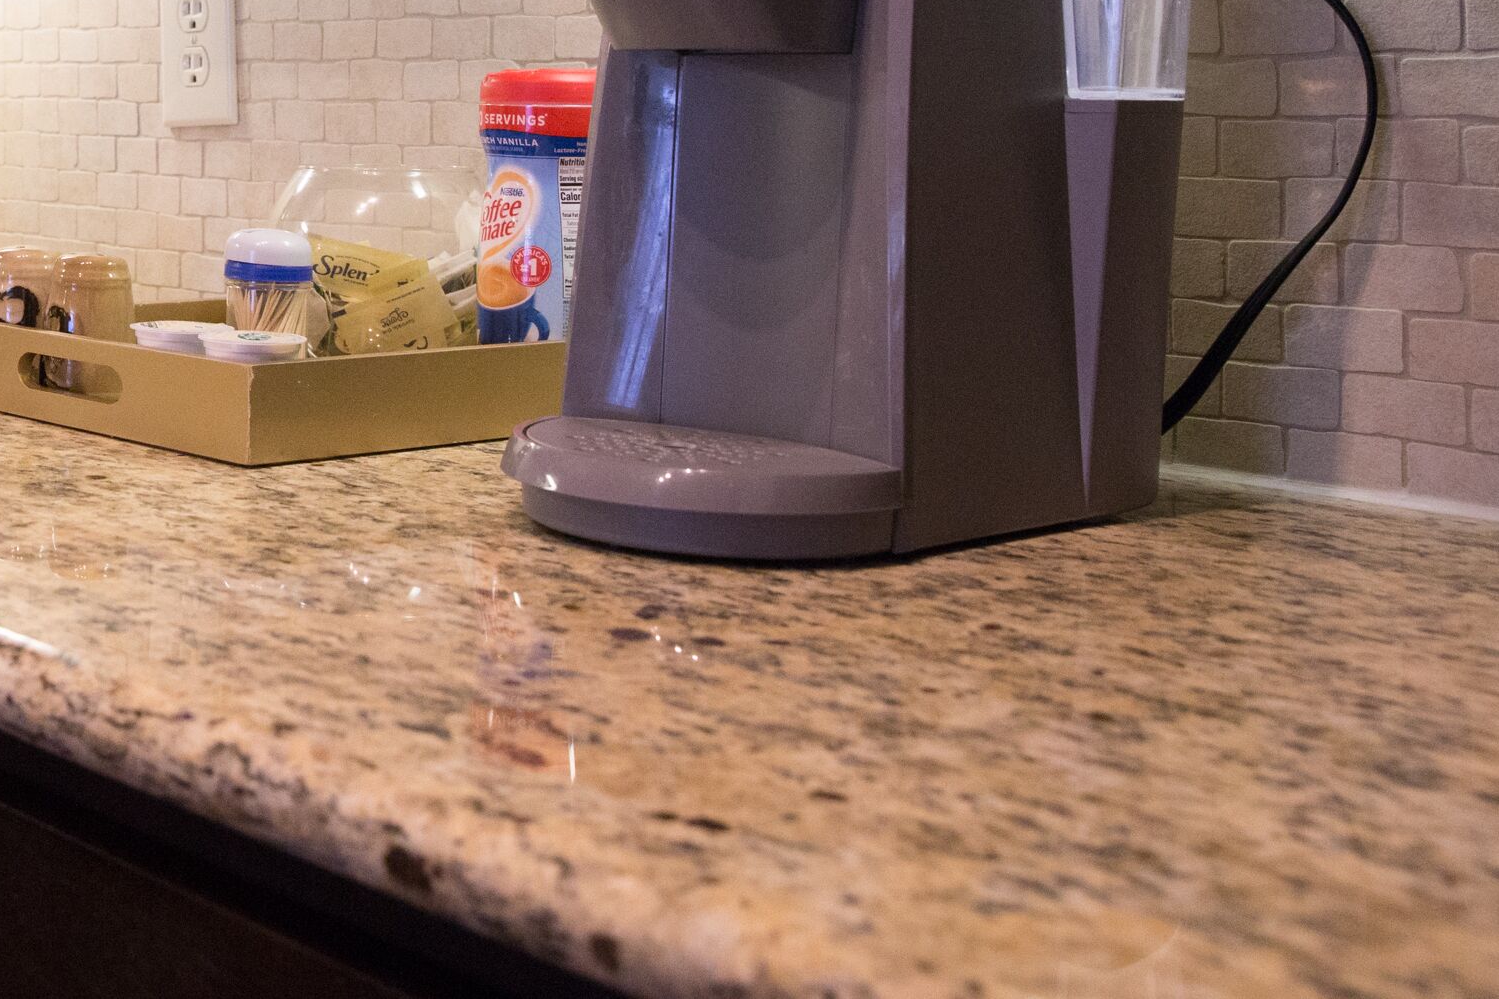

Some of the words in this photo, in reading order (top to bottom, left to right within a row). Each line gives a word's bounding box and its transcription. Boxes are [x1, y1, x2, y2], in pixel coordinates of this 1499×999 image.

[496, 137, 539, 147] VANILLA
[560, 158, 585, 167] Nutritio
[560, 191, 581, 201] Calor
[481, 220, 516, 242] mate
[312, 255, 368, 281] Splen
